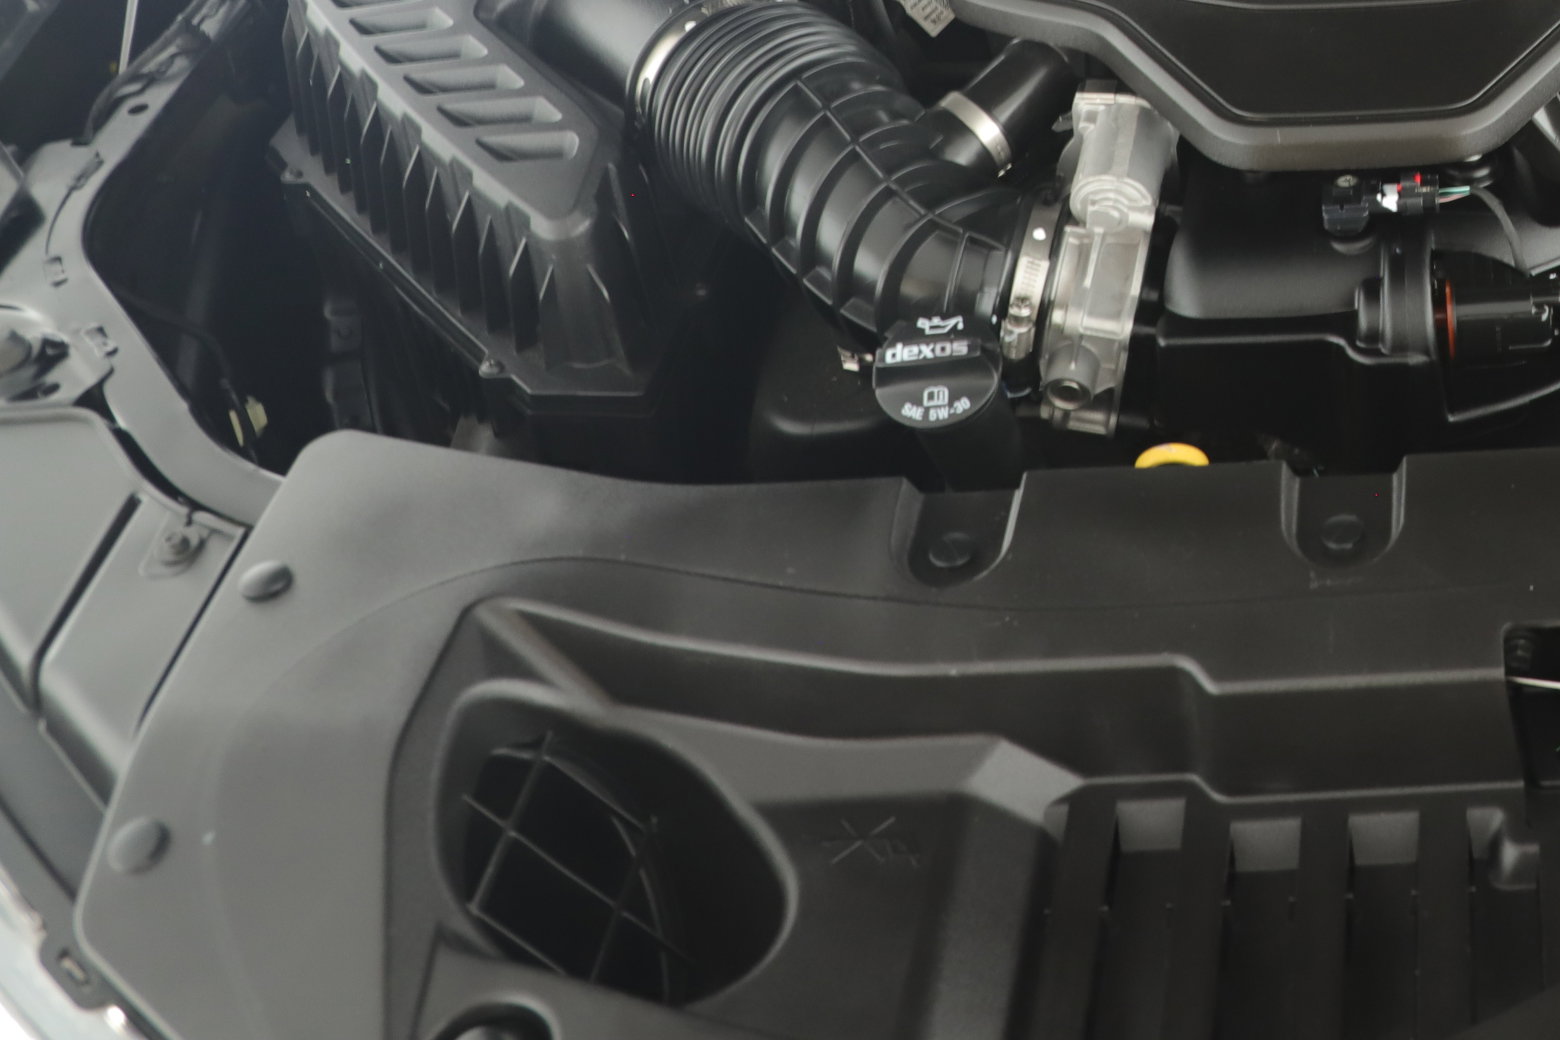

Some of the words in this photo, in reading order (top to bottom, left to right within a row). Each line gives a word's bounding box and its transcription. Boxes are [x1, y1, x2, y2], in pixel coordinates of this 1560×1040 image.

[885, 340, 968, 364] dexos
[901, 402, 924, 420] SAE
[929, 396, 971, 422] 5W-30
